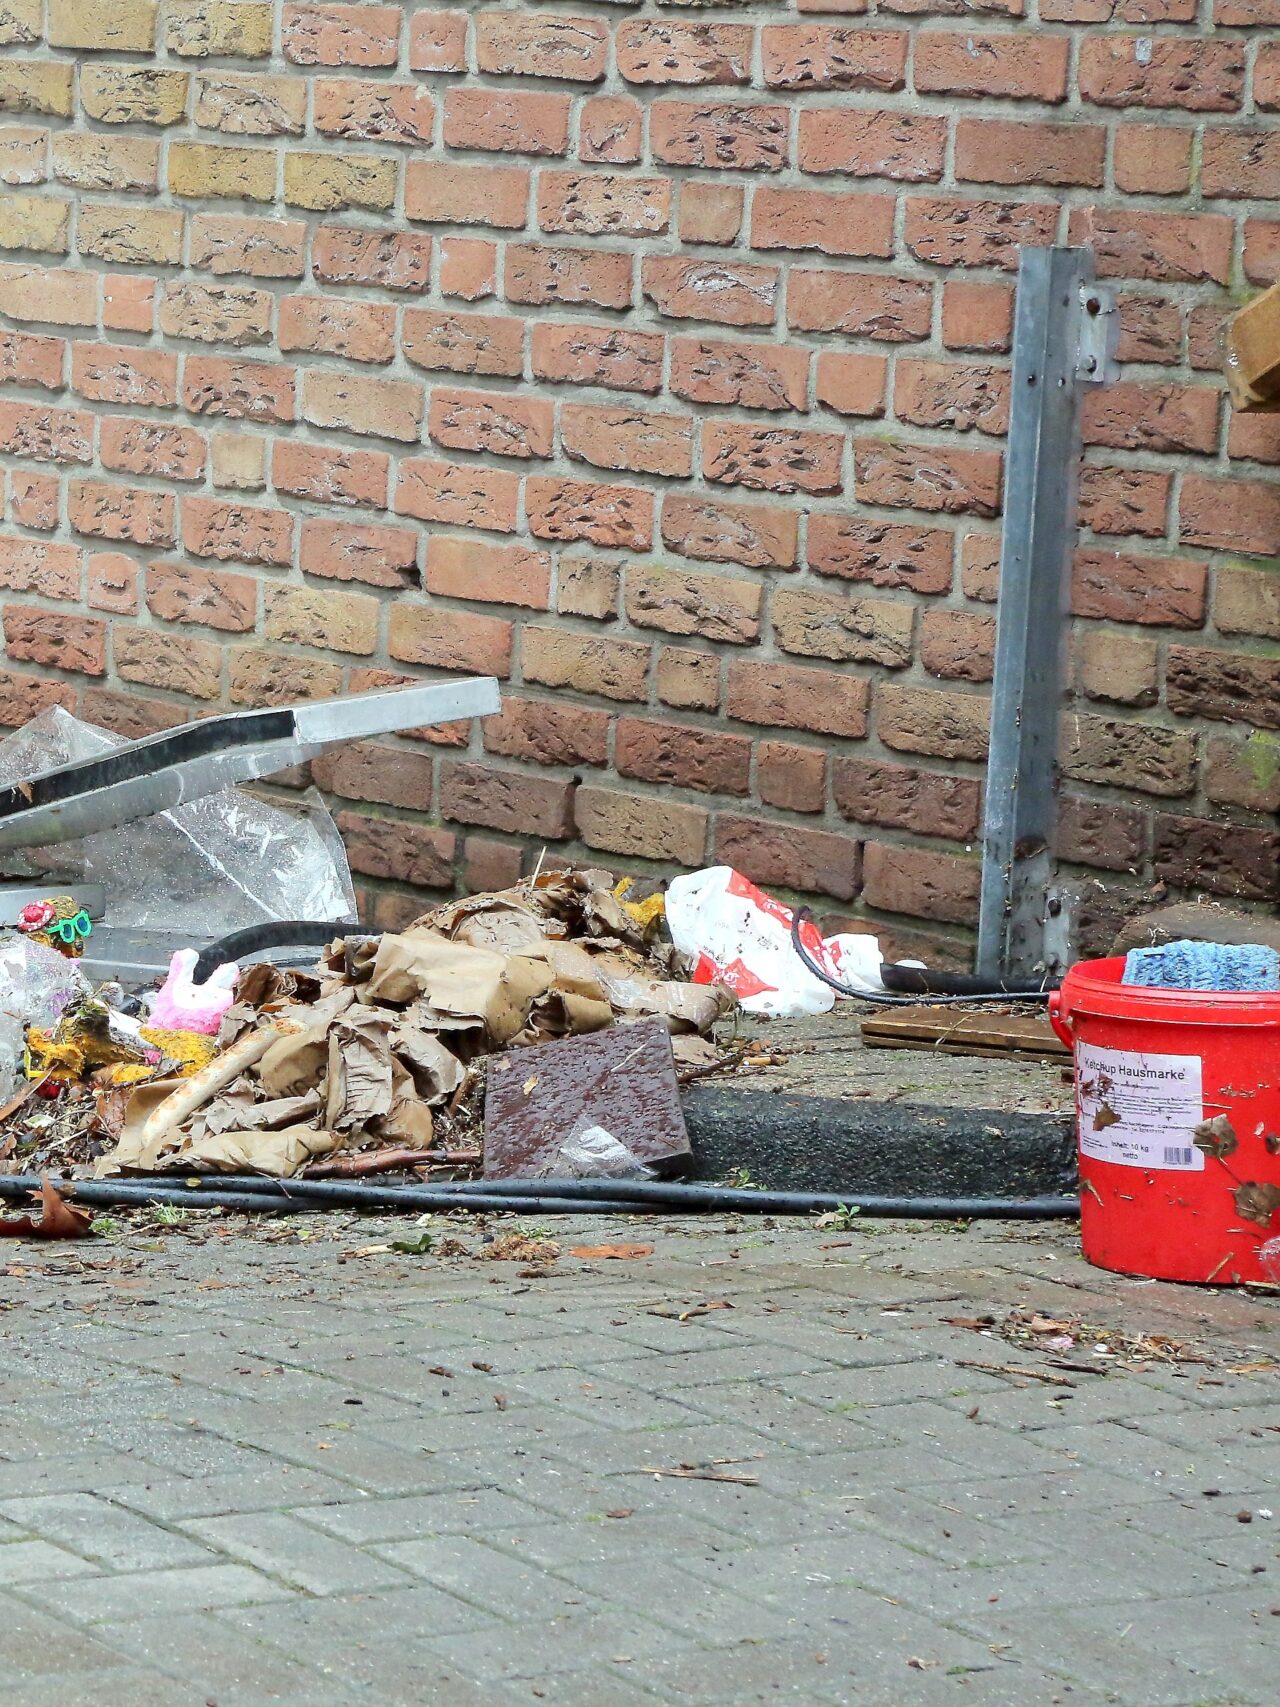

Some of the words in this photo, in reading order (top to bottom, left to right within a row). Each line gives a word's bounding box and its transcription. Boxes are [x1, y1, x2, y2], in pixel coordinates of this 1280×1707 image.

[1084, 1057, 1116, 1074] Ketchup
[1119, 1065, 1185, 1080] Hausmarke
[1140, 1144, 1149, 1153] kg
[1122, 1152, 1138, 1160] netto
